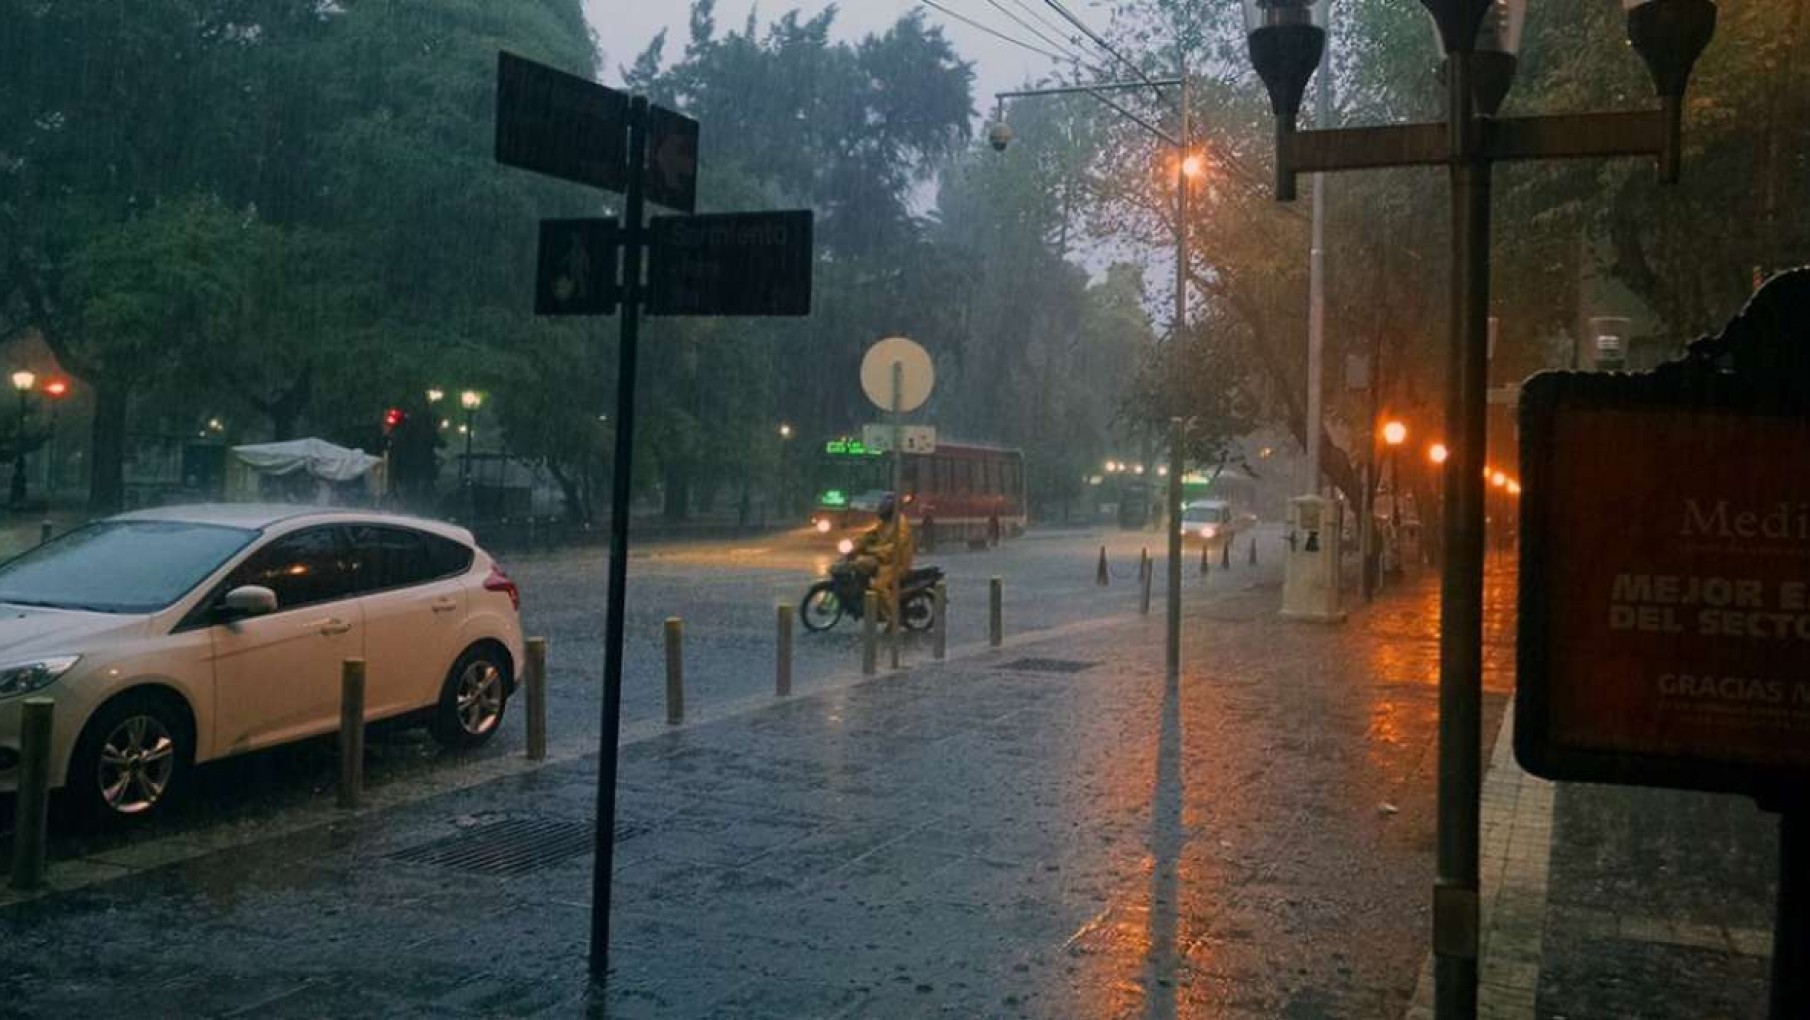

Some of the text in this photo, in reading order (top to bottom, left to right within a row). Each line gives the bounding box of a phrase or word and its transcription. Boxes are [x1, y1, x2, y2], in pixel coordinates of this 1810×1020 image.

[672, 220, 788, 247] Sarmiento
[1612, 575, 1762, 607] MEJOR
[1610, 607, 1682, 632] DEL
[1658, 674, 1782, 703] GRACIAS
